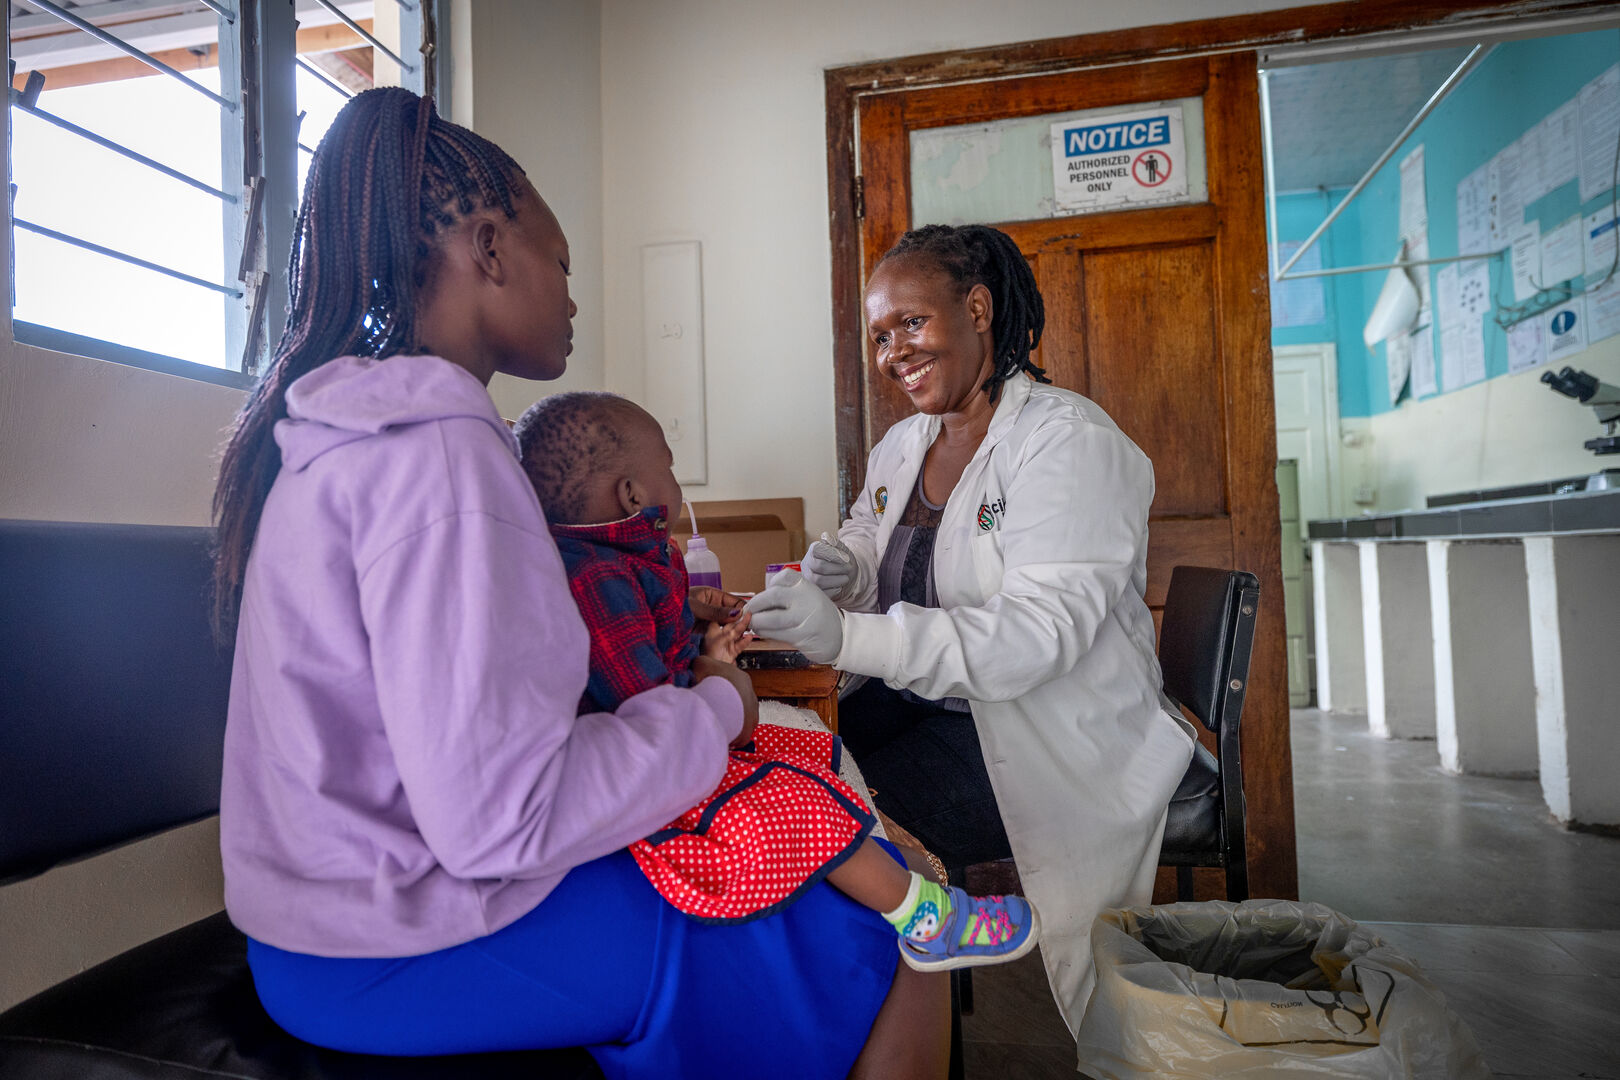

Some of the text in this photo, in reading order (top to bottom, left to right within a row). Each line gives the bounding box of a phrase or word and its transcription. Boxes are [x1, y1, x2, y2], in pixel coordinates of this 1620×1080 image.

[1069, 120, 1165, 153] NOTICE
[1067, 155, 1131, 171] AUTHORIZED
[1069, 167, 1129, 183] PERSONNEL
[1087, 182, 1113, 193] ONLY
